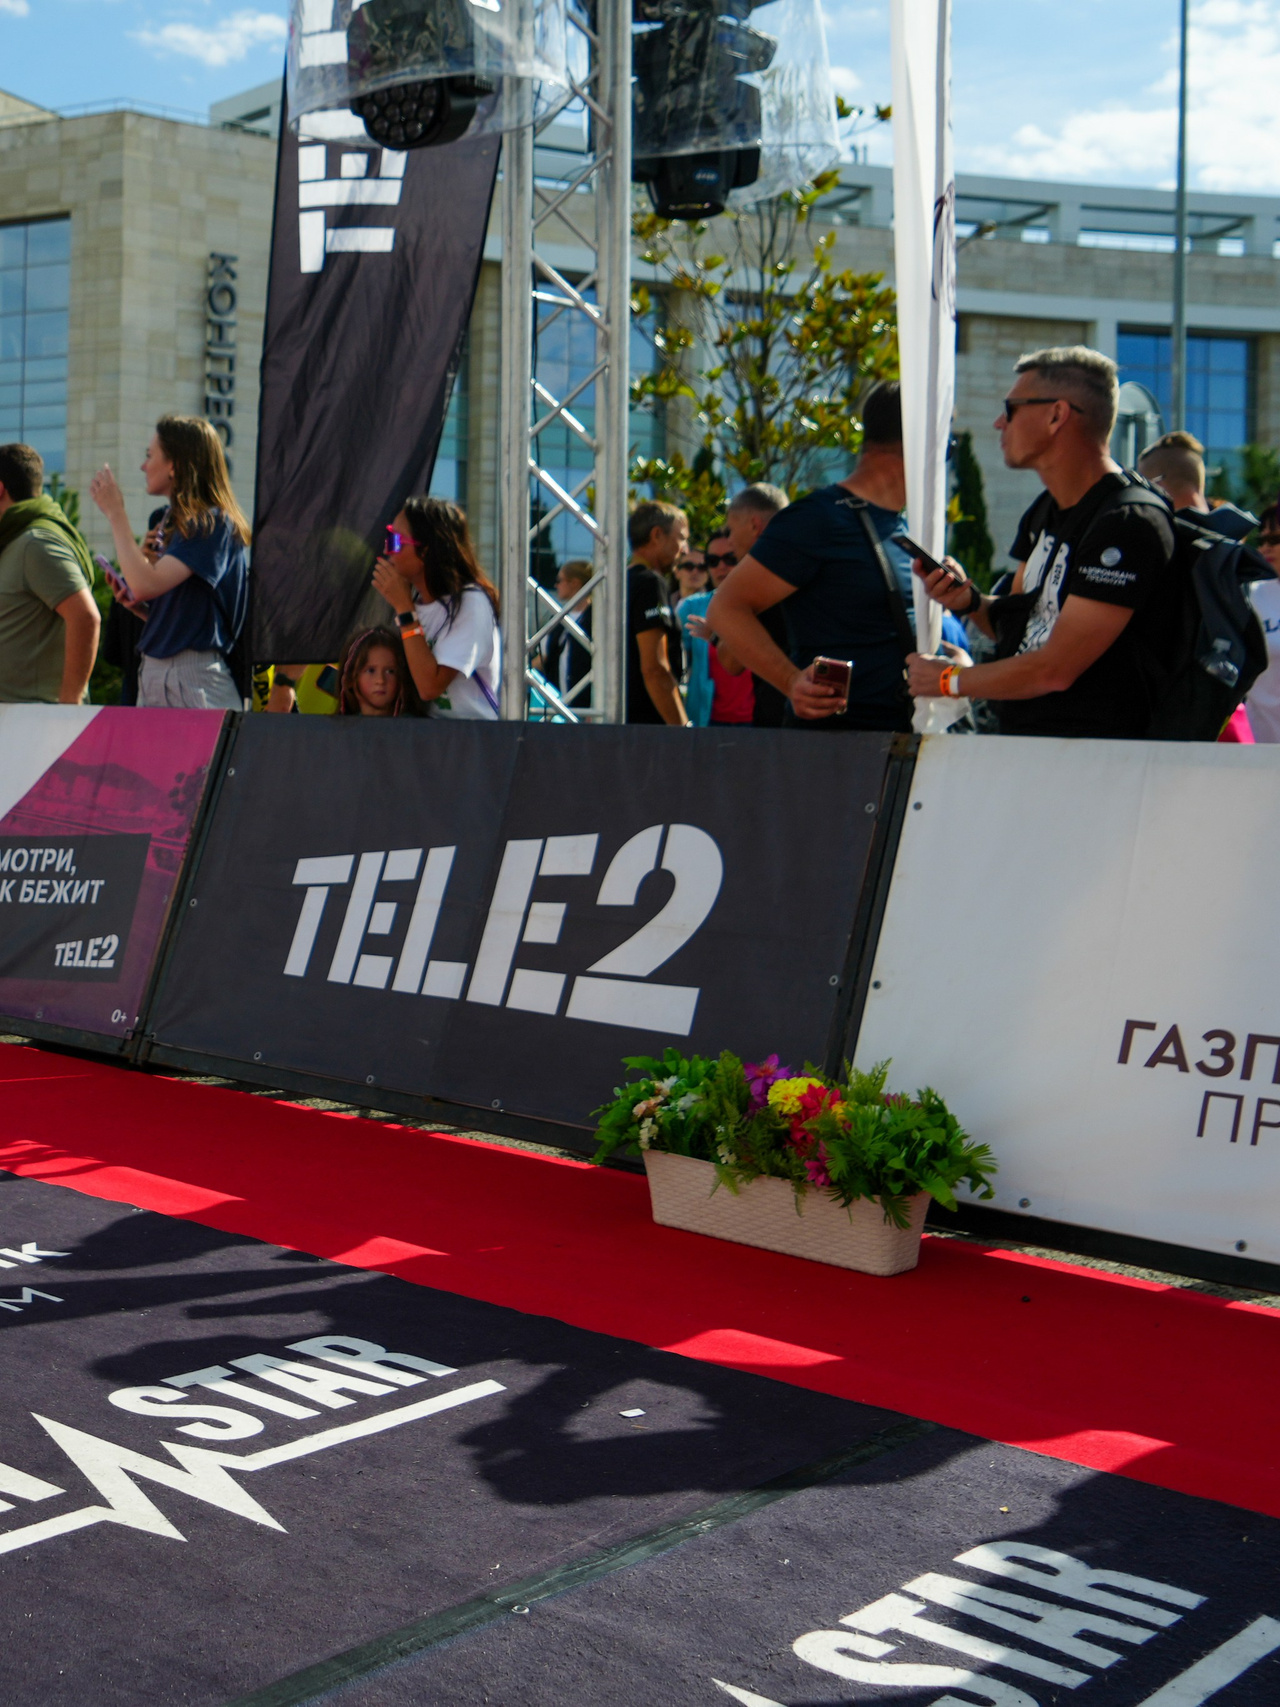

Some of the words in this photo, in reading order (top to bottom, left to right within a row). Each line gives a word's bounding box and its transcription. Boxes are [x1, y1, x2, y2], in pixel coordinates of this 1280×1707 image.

[18, 879, 106, 904] БЕЖИТ
[54, 933, 120, 968] TELE2
[282, 823, 724, 1037] TELE2
[111, 1008, 128, 1023] 0+
[107, 1334, 459, 1441] STAR
[792, 1540, 1209, 1707] STAR
